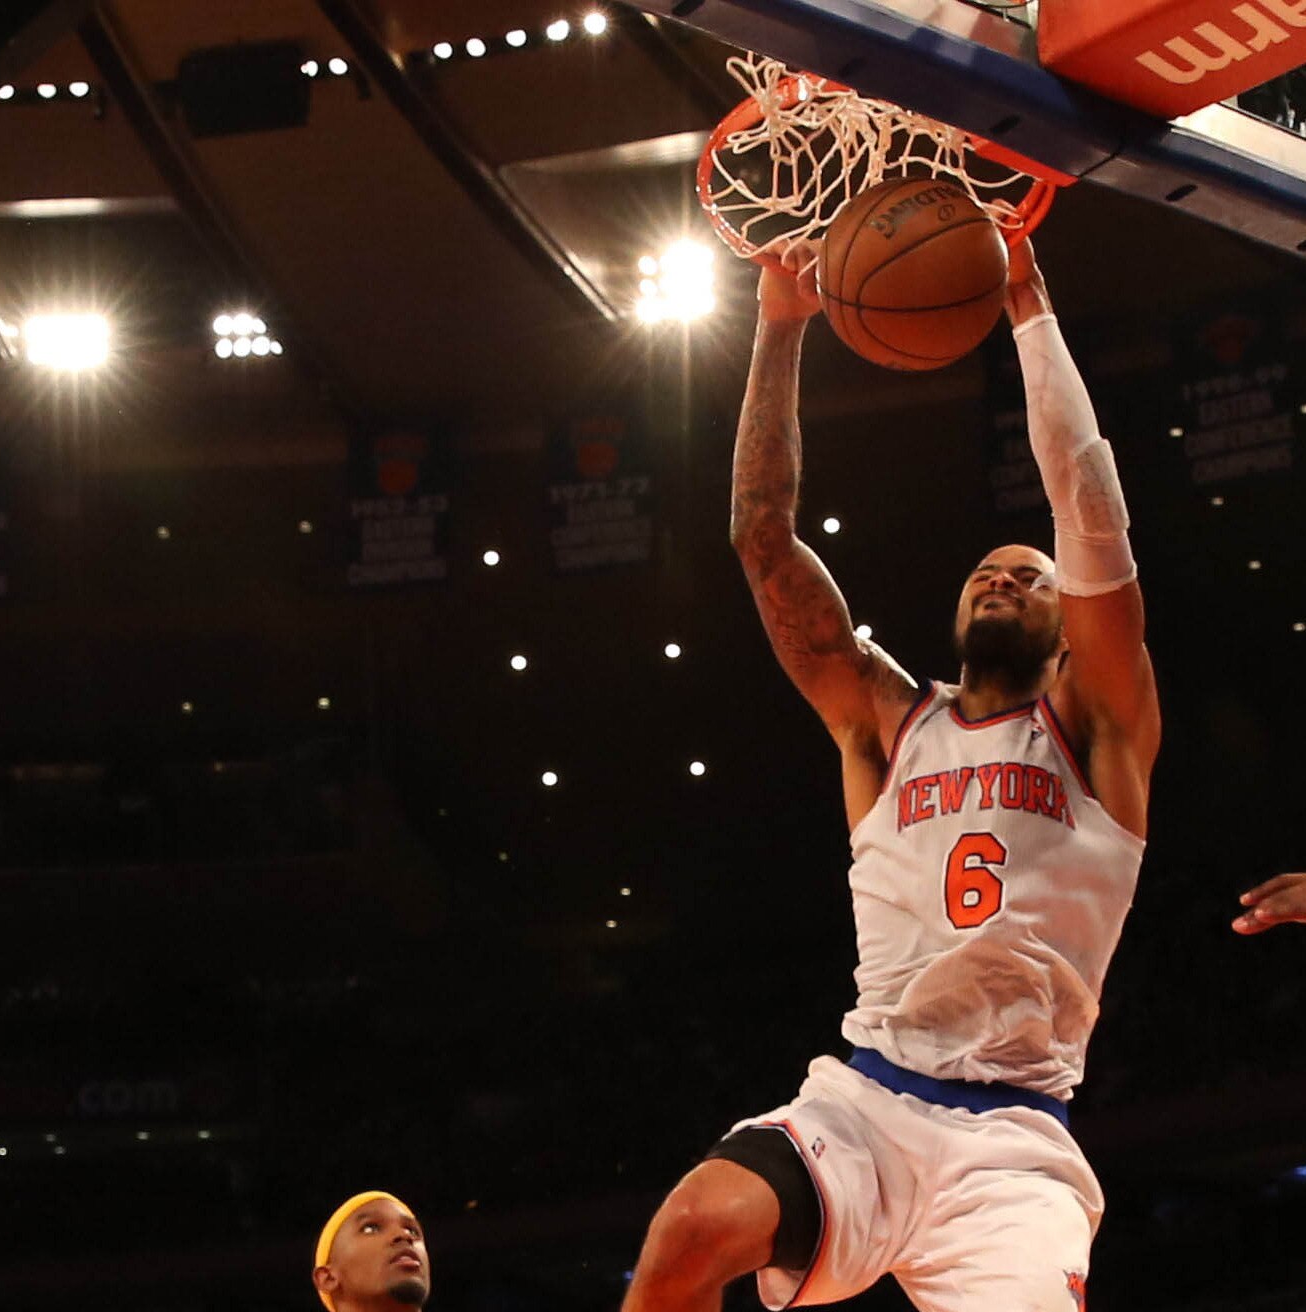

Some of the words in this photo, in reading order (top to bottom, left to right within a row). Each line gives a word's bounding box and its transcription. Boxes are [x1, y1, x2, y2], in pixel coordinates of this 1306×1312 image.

[897, 766, 975, 834] NEW
[975, 761, 1076, 831] YORK
[943, 831, 1008, 931] 6
